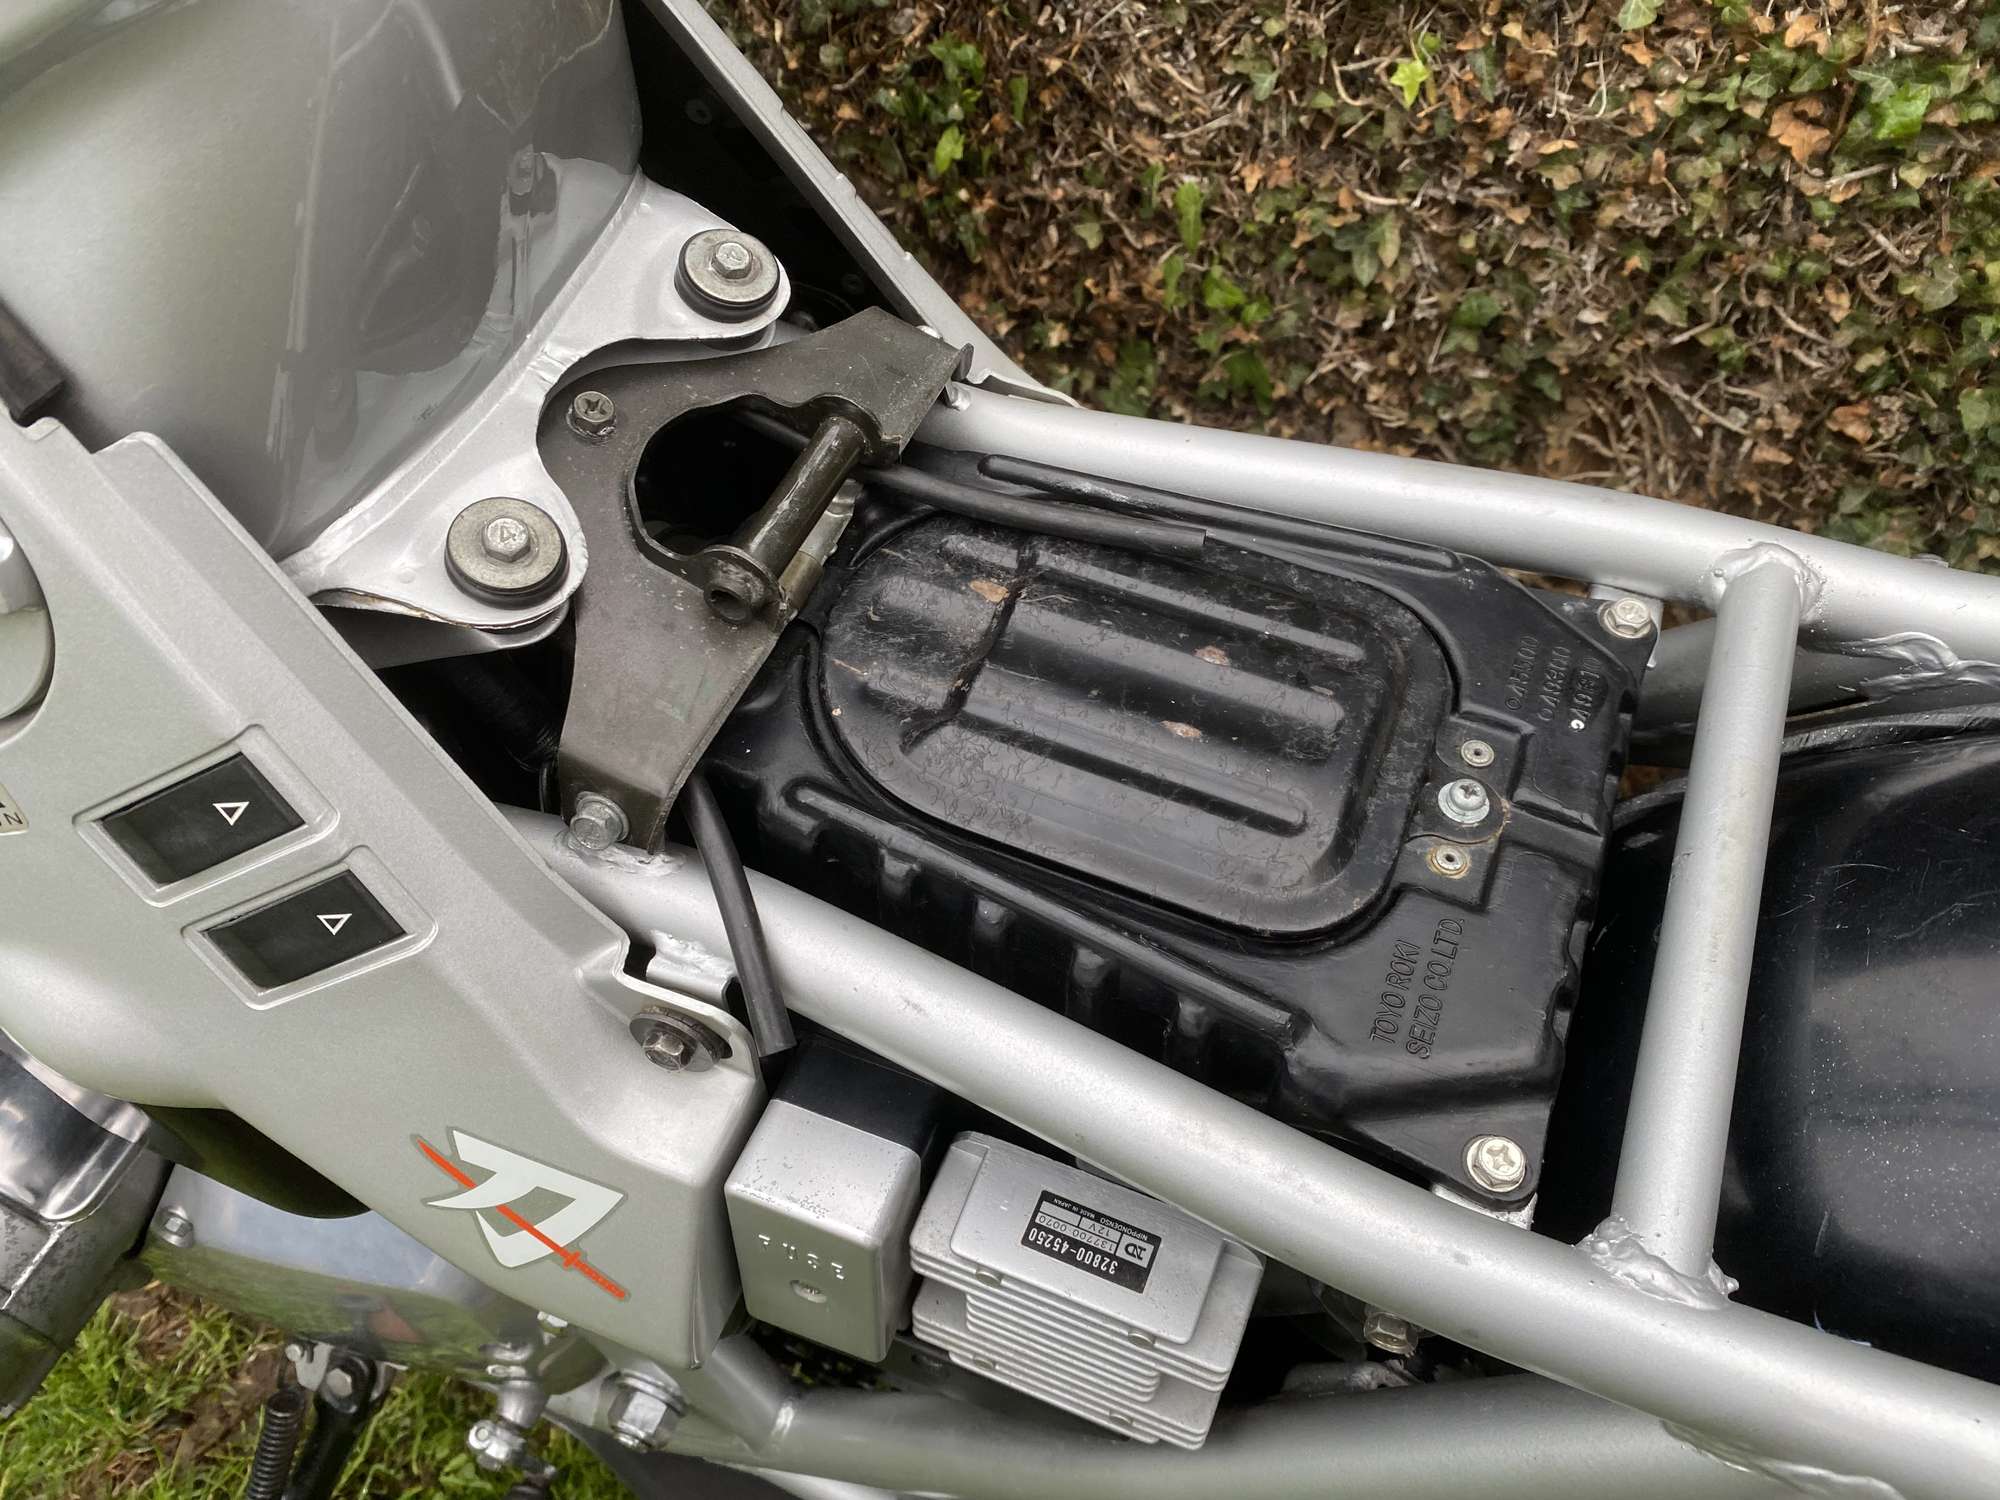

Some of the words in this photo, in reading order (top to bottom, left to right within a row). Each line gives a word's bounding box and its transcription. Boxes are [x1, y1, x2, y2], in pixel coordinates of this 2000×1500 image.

[1386, 939, 1421, 990] ROKI
[1369, 991, 1406, 1044] TOYO
[1405, 994, 1443, 1060] SEIZO
[1053, 1198, 1072, 1209] JAPAN
[1079, 1209, 1095, 1219] MADE
[1040, 1215, 1113, 1252] 137700-0070
[1088, 1223, 1110, 1237] 12V
[1099, 1217, 1148, 1242] NIPPONDENSO
[1028, 1227, 1119, 1275] 32800-45250
